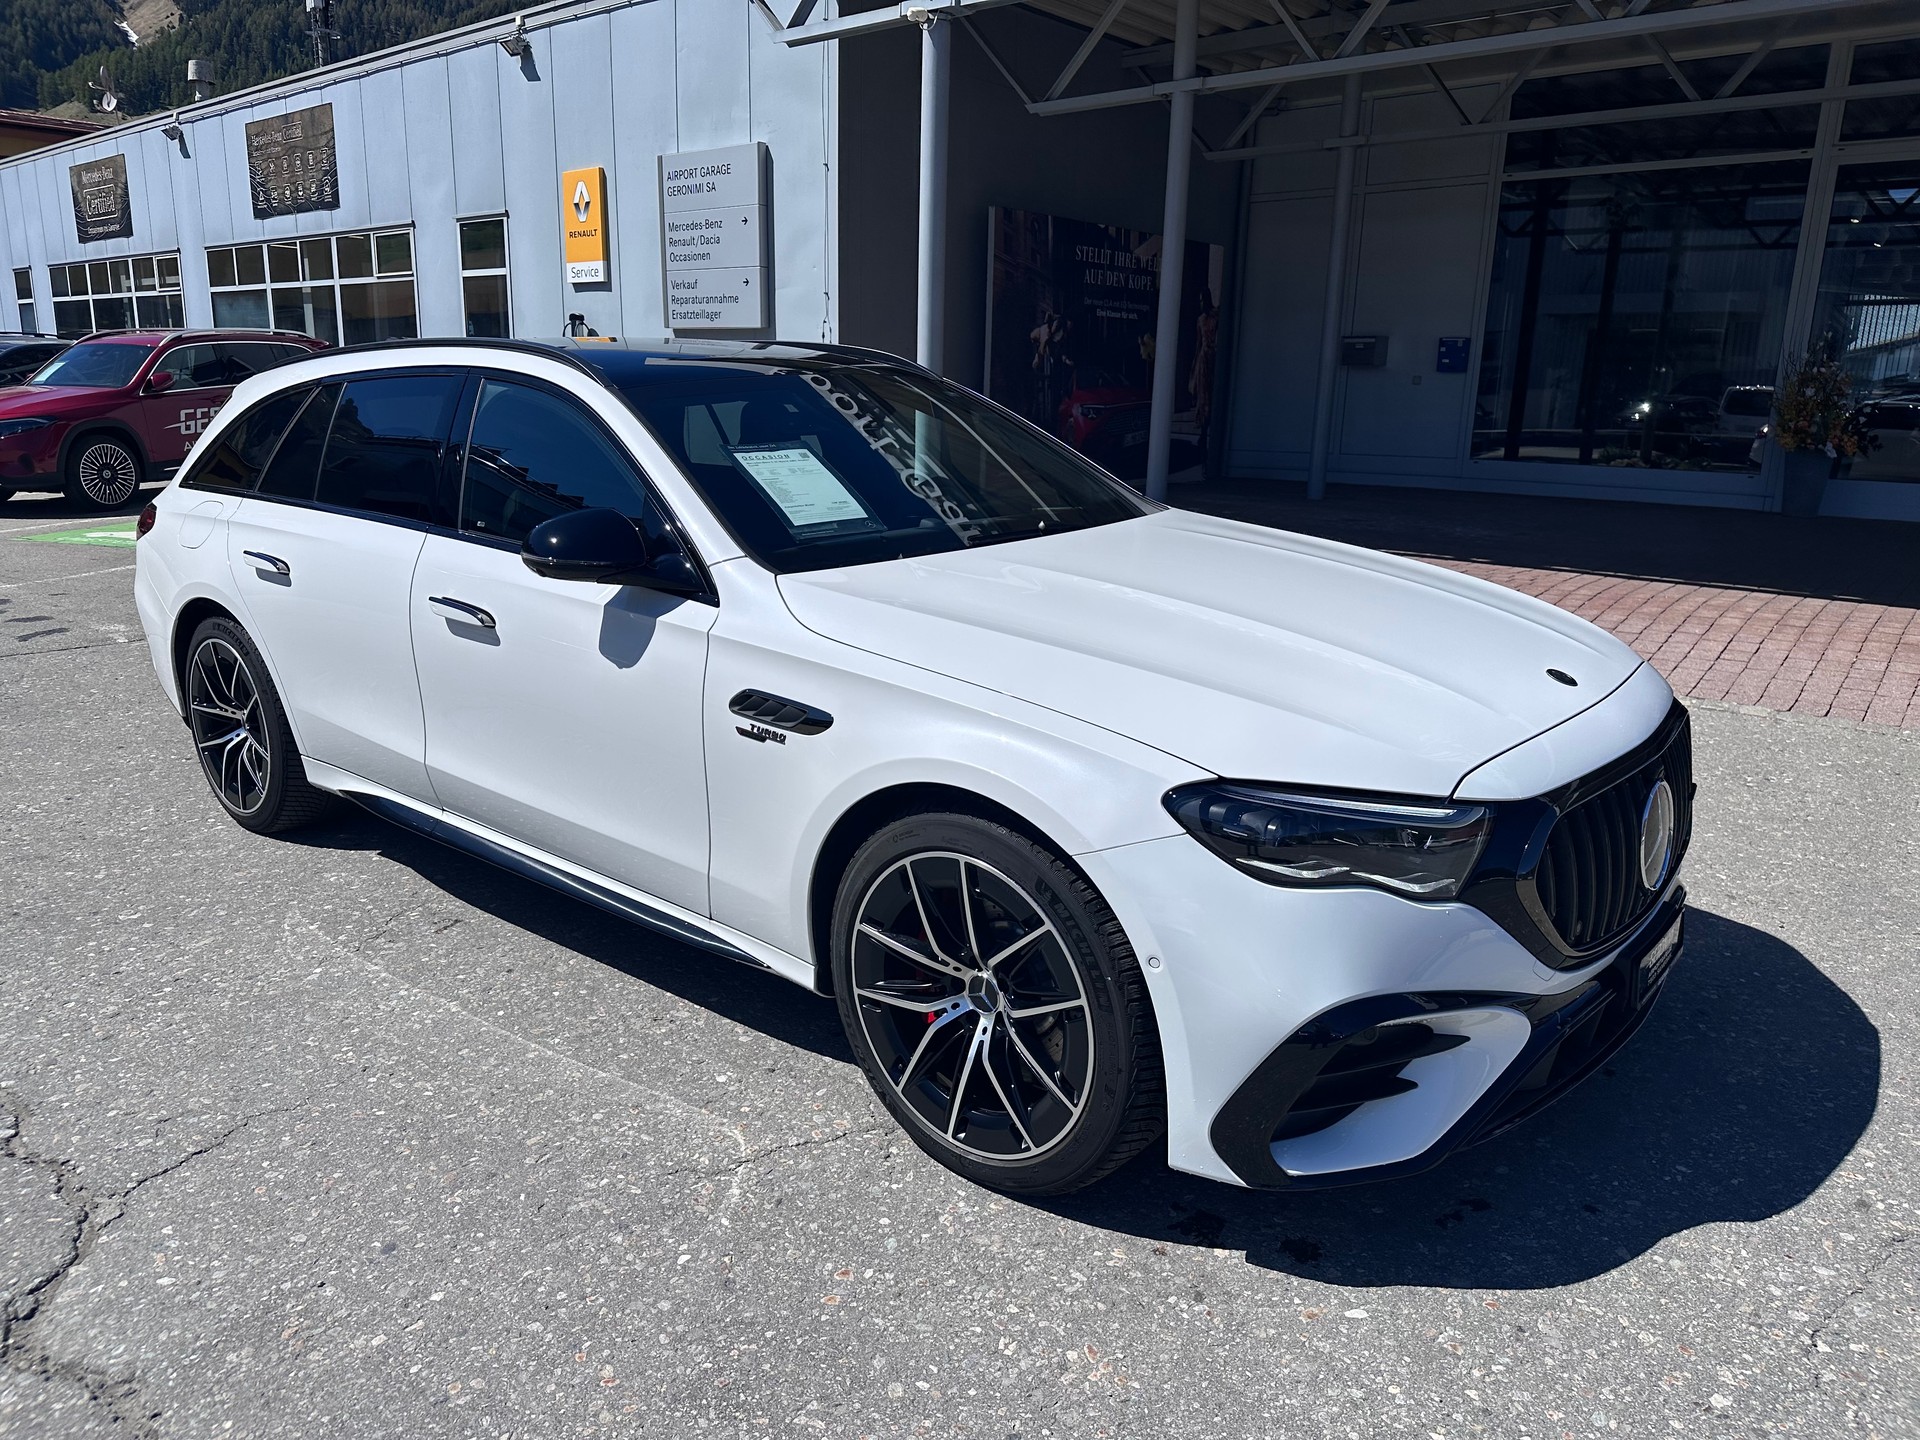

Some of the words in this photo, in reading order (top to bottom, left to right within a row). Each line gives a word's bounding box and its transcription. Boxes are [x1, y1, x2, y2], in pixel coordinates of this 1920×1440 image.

[667, 167, 698, 182] AIRPORT
[699, 163, 732, 177] GARAGE
[667, 183, 704, 197] GERONIMI
[706, 181, 716, 193] SA
[668, 218, 723, 233] Mercedes-Benz
[568, 228, 598, 239] RENAULT
[669, 235, 721, 248] Renault/Dacia
[669, 250, 711, 262] Occasionen
[1075, 245, 1112, 264] STELLT
[1114, 250, 1137, 269] IHRE
[1140, 255, 1161, 272] WEL
[571, 265, 599, 279] Service
[671, 278, 698, 290] Verkauf
[1083, 268, 1104, 285] AUF
[1106, 271, 1126, 287] DEN
[1128, 274, 1154, 291] KOPF.
[671, 293, 739, 306] Reparaturannahme
[671, 307, 722, 320] Ersatzteillager
[1054, 902, 1112, 1007] MICHELIN
